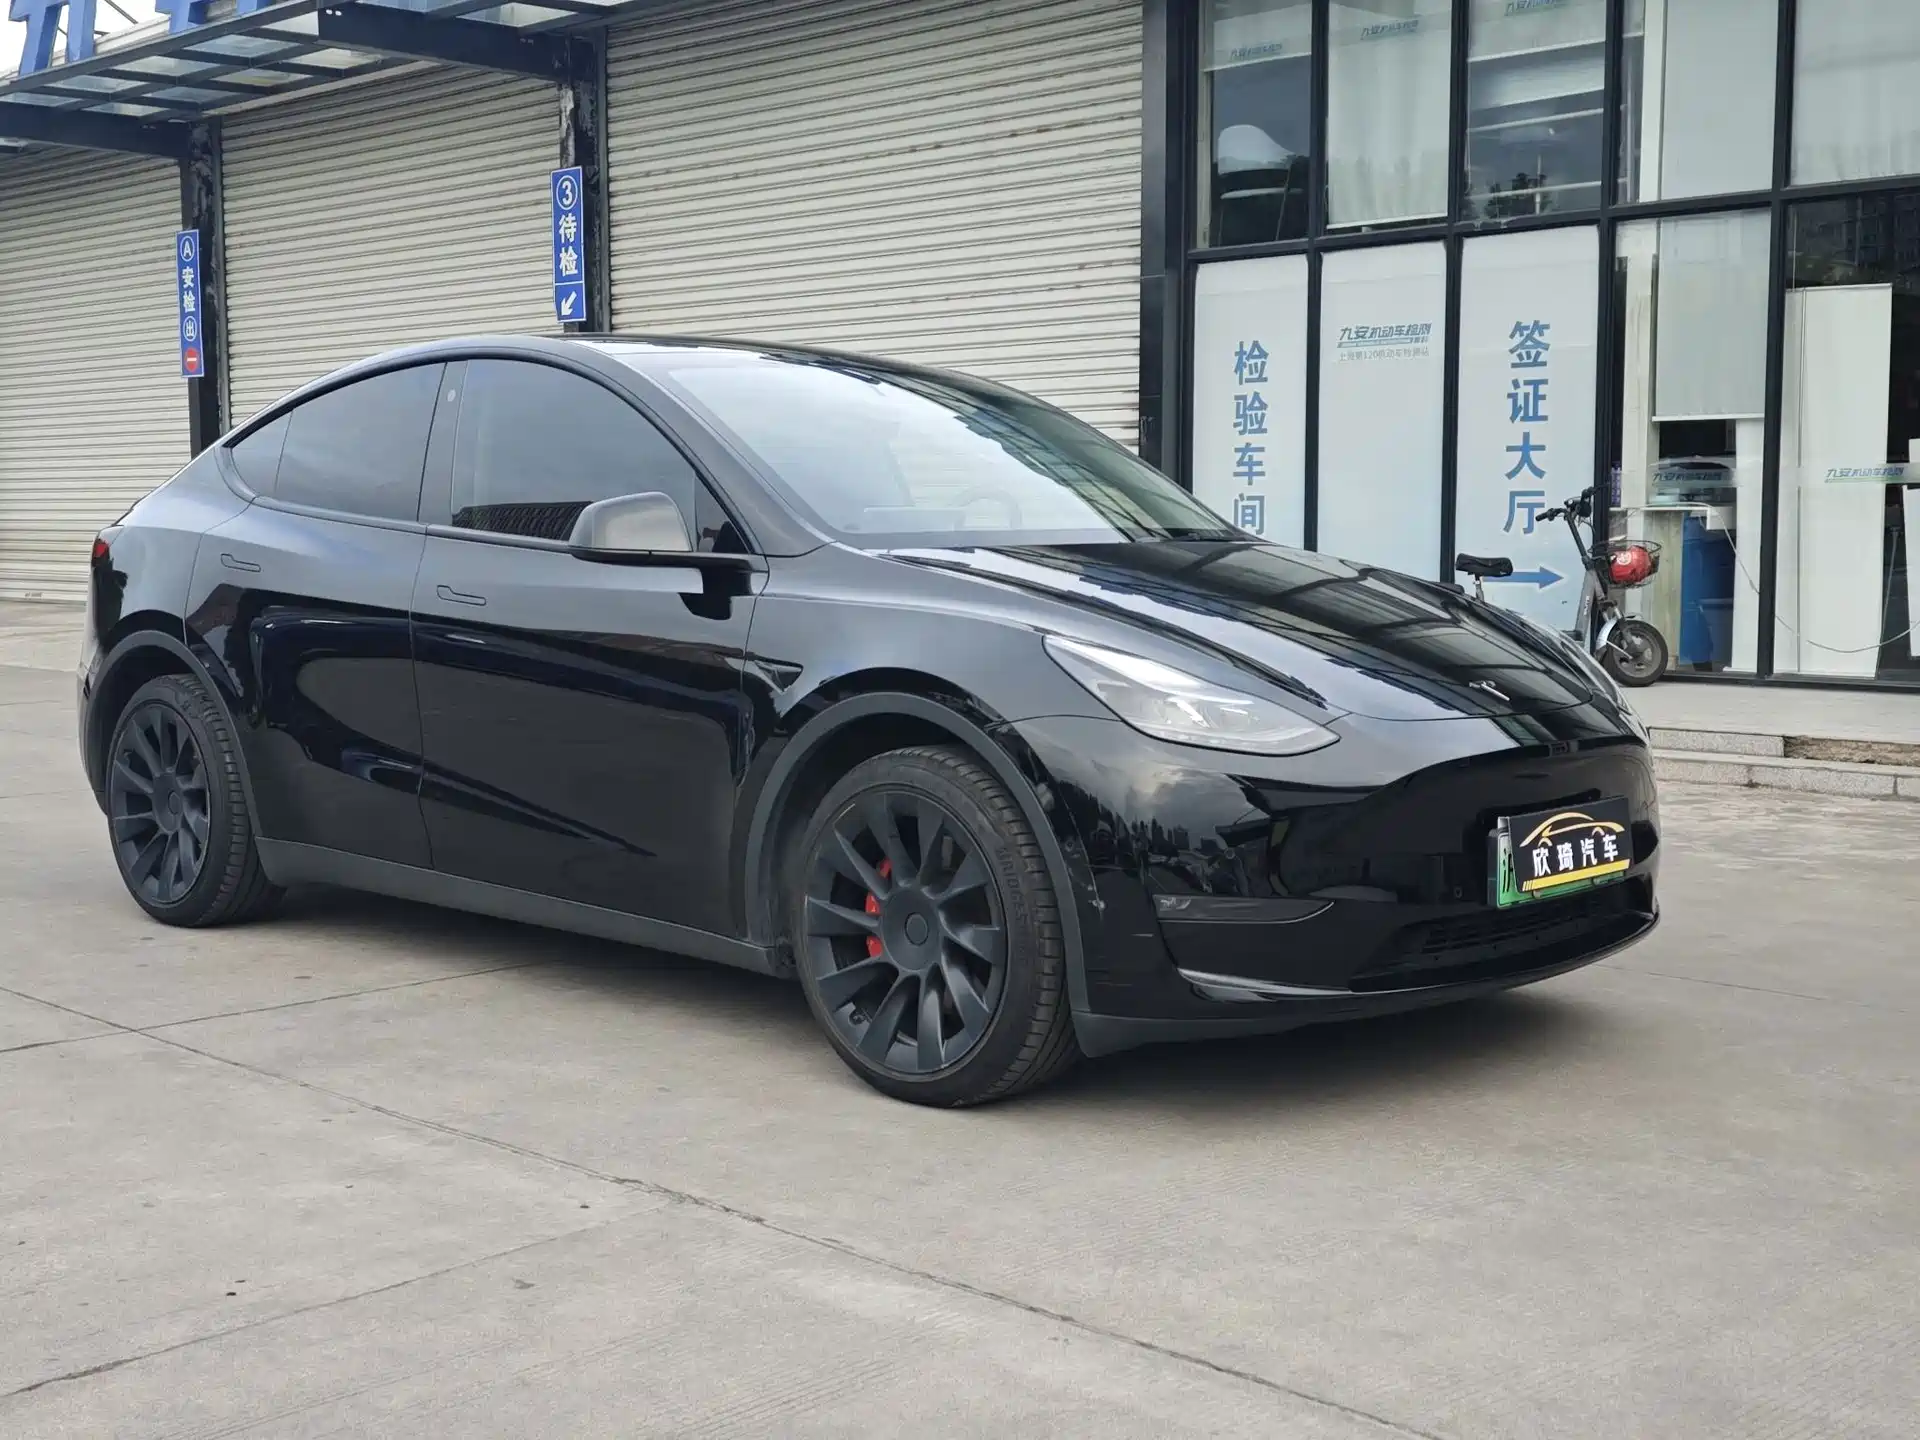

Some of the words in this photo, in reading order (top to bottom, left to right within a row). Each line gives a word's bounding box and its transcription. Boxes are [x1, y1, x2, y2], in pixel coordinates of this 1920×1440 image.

[1233, 340, 1269, 535] 检验车间
[1503, 320, 1551, 534] 签证大厅
[1532, 834, 1619, 877] 欣琦汽车
